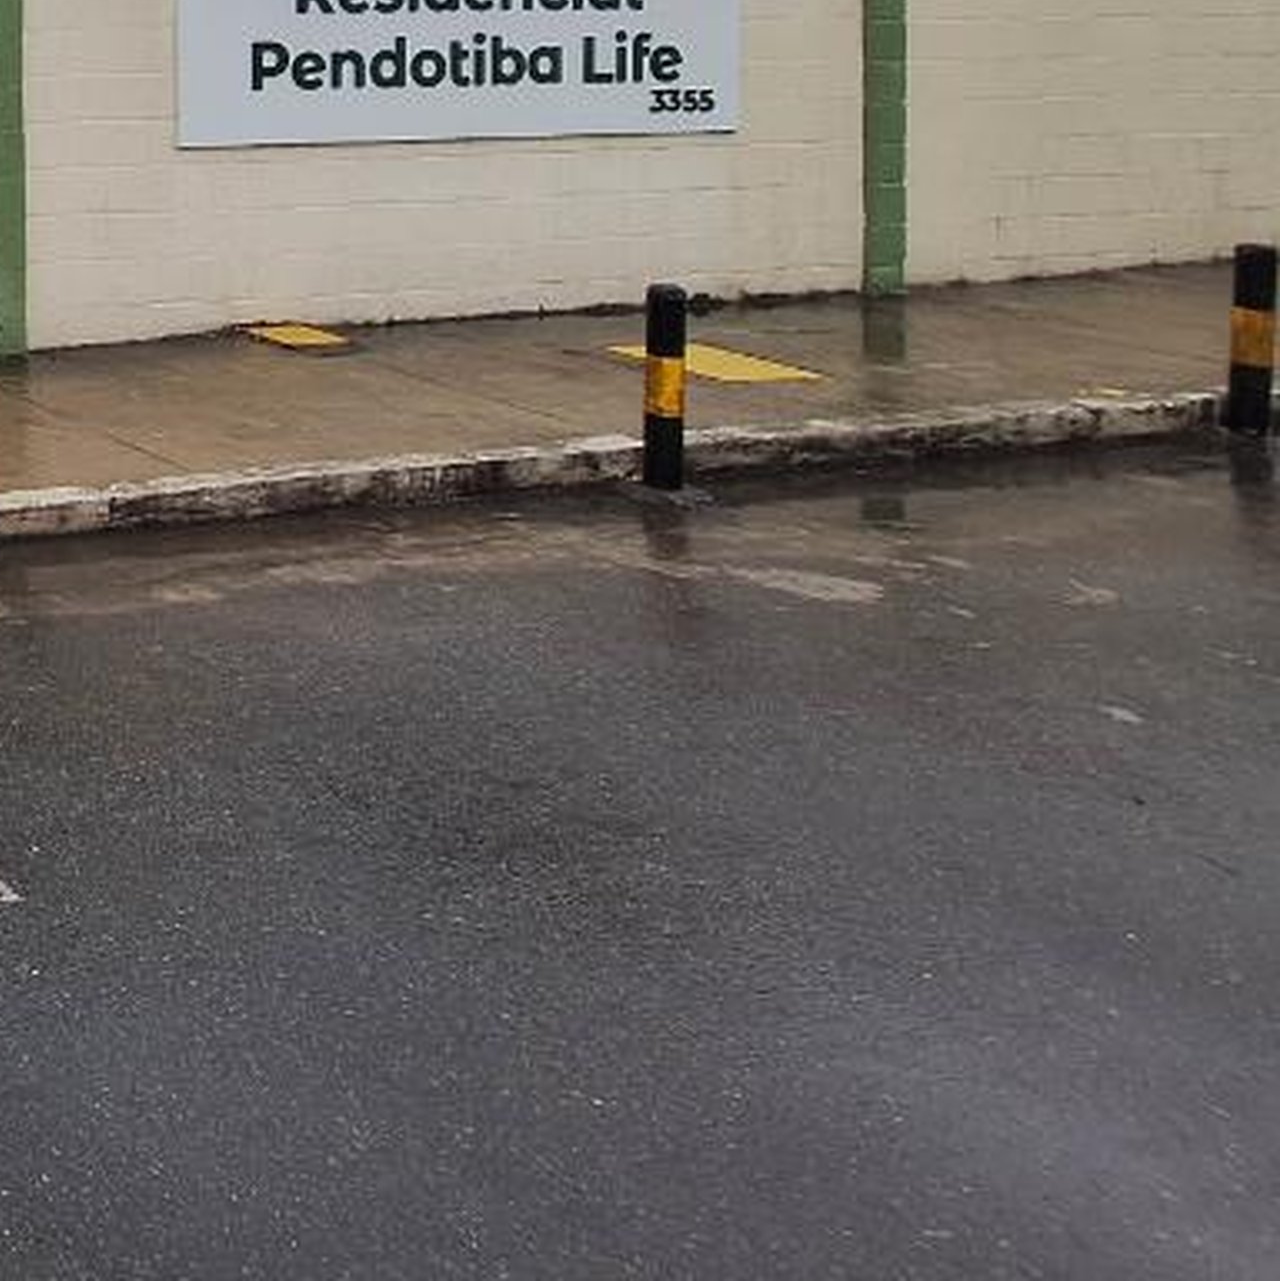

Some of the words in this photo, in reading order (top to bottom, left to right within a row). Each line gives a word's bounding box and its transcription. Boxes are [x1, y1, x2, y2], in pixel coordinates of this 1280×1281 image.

[250, 32, 564, 92] Pendotiba
[582, 32, 684, 86] Life
[648, 89, 716, 114] 3355
